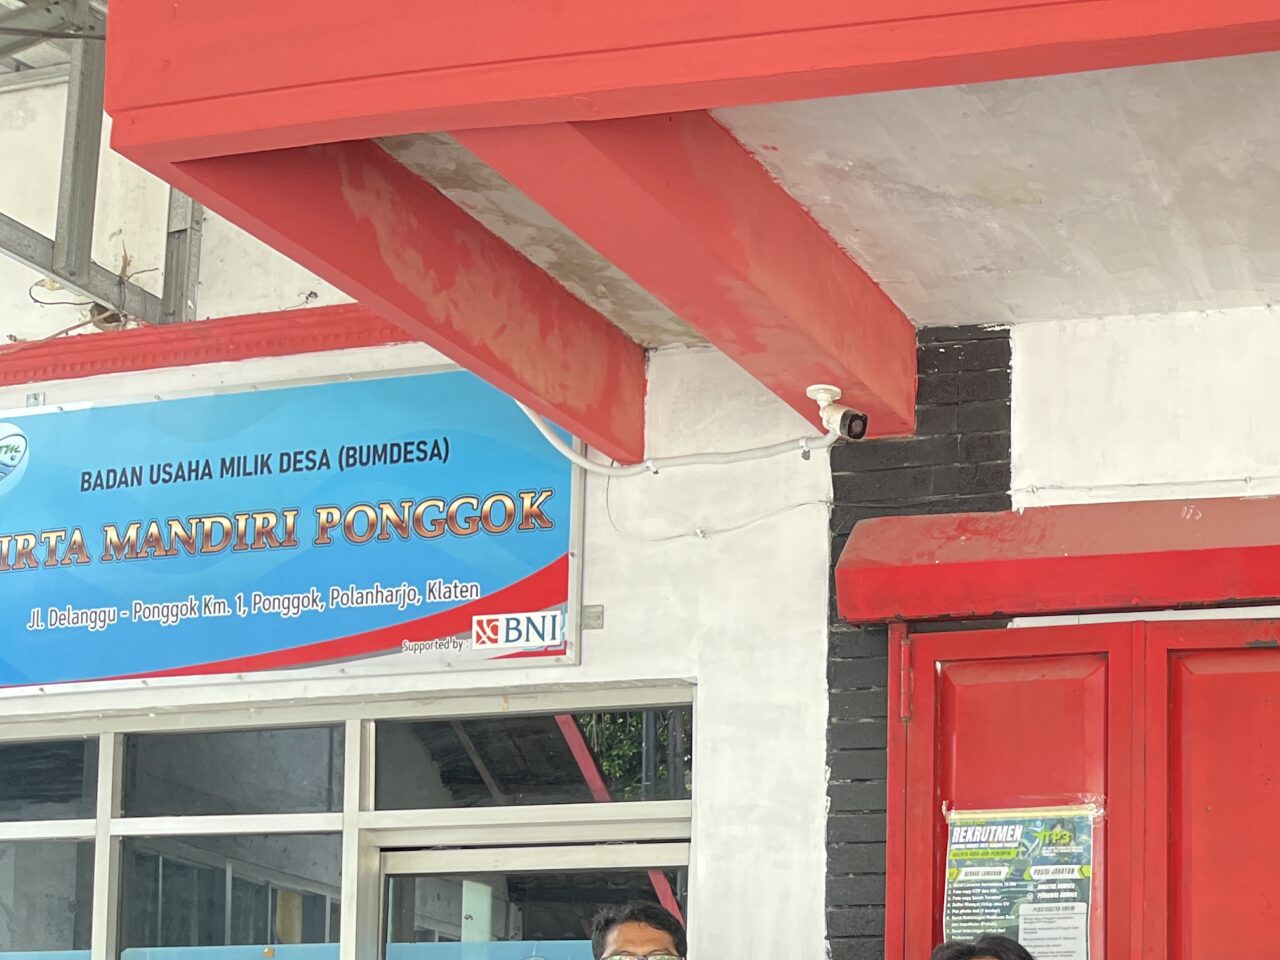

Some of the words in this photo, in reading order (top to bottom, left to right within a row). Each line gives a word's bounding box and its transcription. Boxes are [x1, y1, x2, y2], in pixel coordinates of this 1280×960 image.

[80, 465, 143, 492] BADAN
[150, 459, 213, 485] USAHA
[220, 454, 272, 478] MILIK
[279, 448, 331, 474] DESA
[338, 437, 450, 472] (BUMDESA)
[101, 509, 299, 561] MANDIRI
[313, 488, 554, 545] PONGGOK
[27, 609, 44, 629] Jl.
[50, 607, 117, 630] Delanggu
[133, 597, 197, 624] Ponggok
[203, 596, 231, 616] Km.
[236, 594, 248, 616] 1,
[252, 587, 325, 617] Ponggok,
[330, 584, 422, 610] Polanharjo,
[427, 579, 480, 600] Klaten
[402, 639, 448, 652] Supported
[451, 639, 464, 651] by
[504, 615, 558, 643] BNI
[952, 825, 1024, 843] REKRUTMEN
